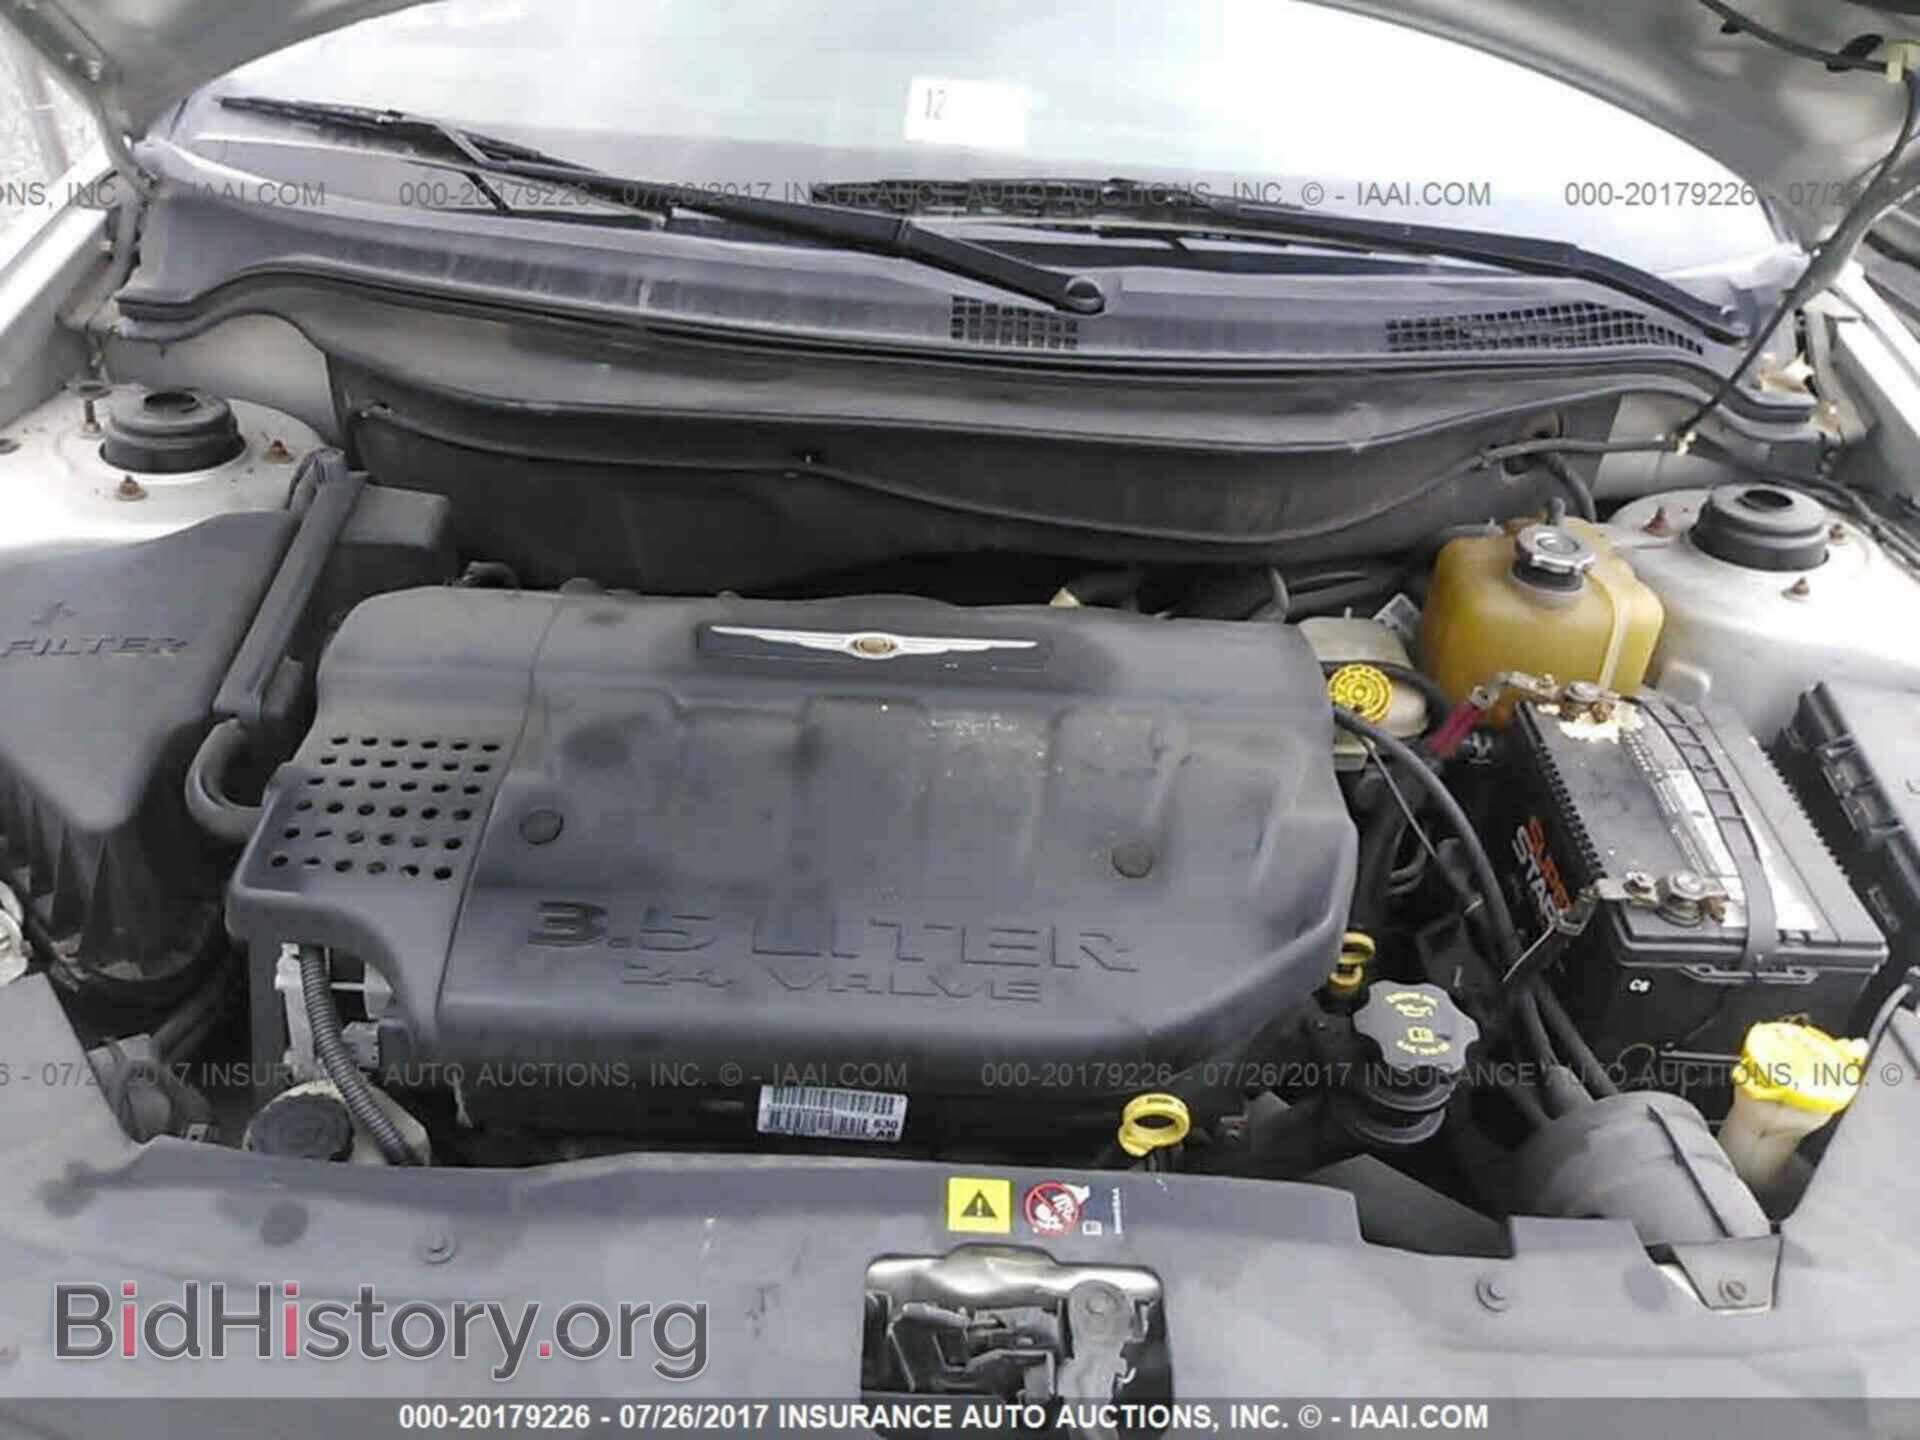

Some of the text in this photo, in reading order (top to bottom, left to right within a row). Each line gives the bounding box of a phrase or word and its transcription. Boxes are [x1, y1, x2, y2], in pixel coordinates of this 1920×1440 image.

[527, 900, 1142, 973] 3.5 LITER
[619, 962, 1042, 1003] 24 VALVE
